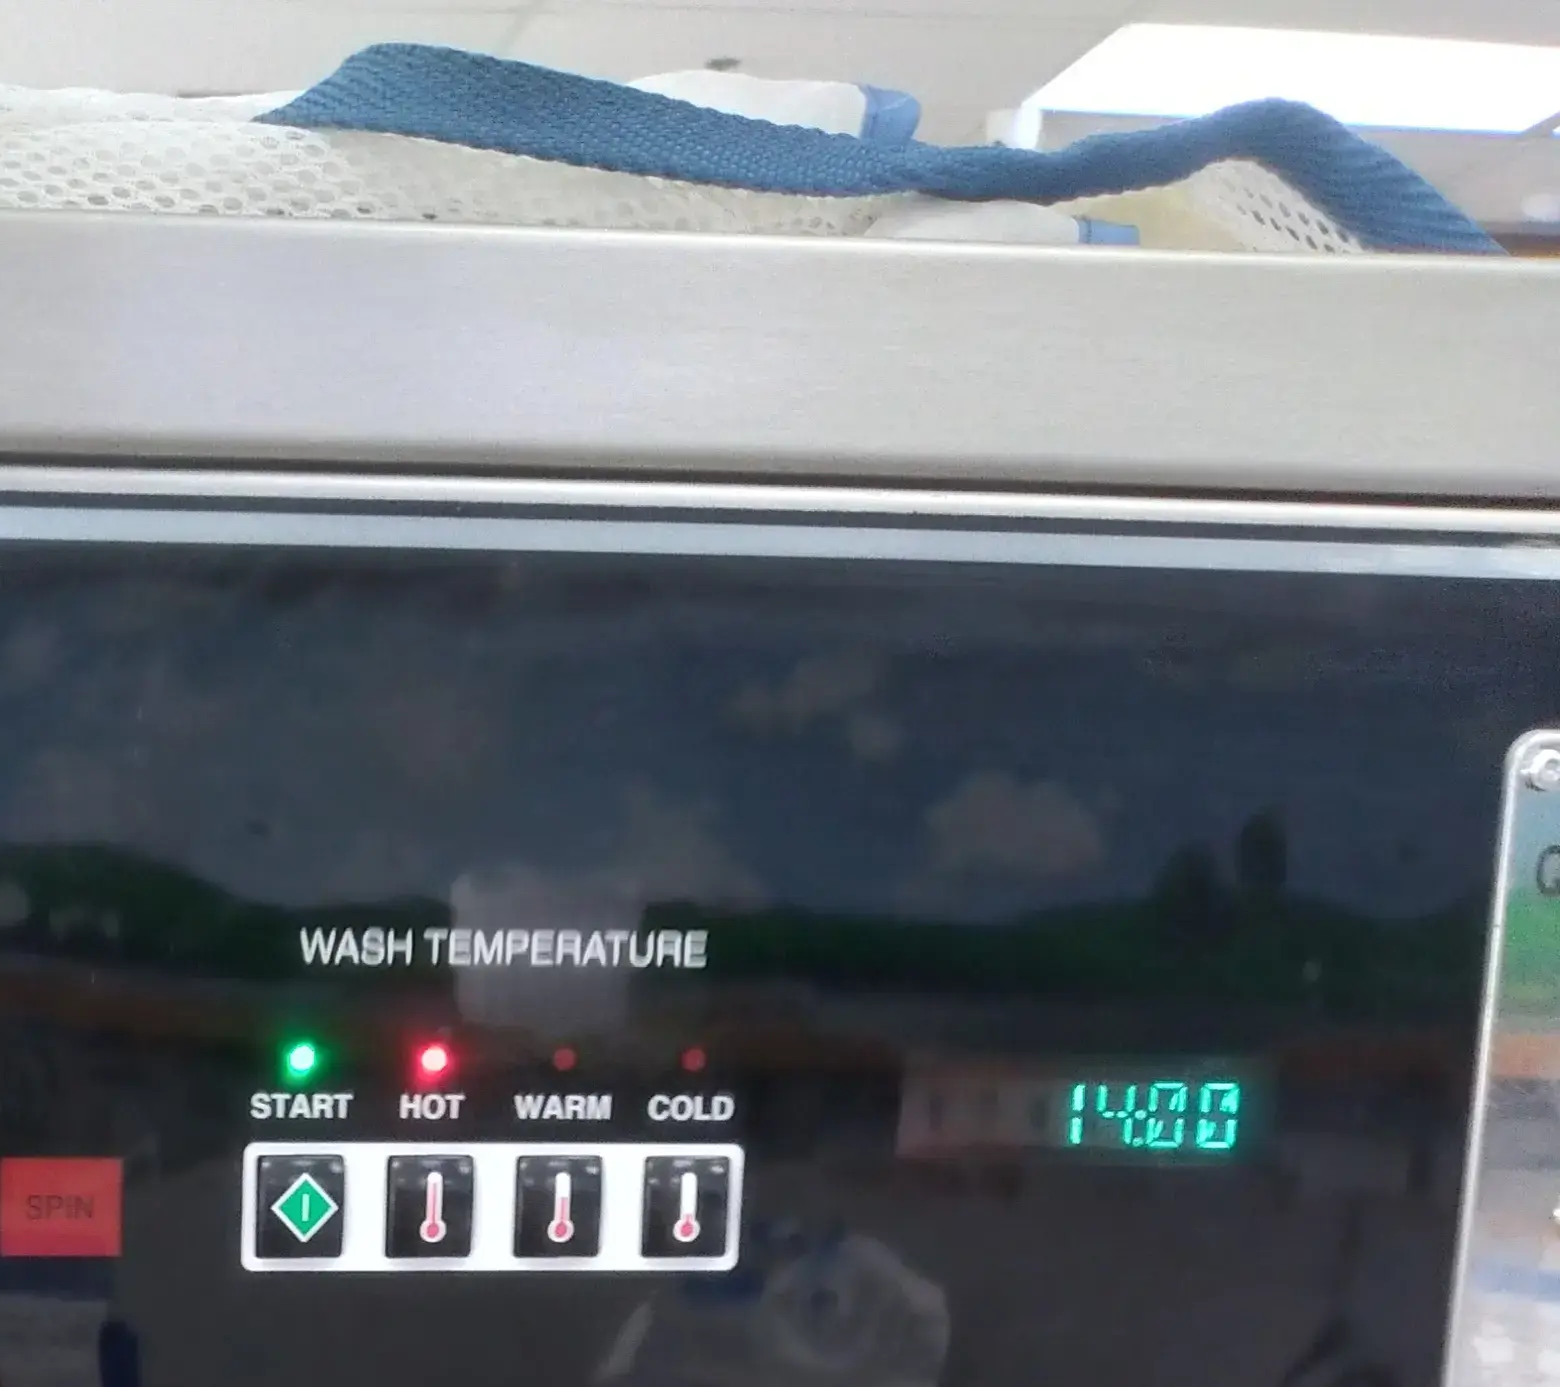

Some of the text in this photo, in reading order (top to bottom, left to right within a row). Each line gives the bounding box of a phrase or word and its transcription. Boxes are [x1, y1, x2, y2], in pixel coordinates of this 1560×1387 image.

[300, 926, 708, 968] WASH TEMPERATURE
[249, 1092, 354, 1121] START
[398, 1092, 466, 1121] HOT
[513, 1093, 613, 1122] WARM
[646, 1094, 735, 1122] COLD
[25, 1194, 96, 1220] SPIN
